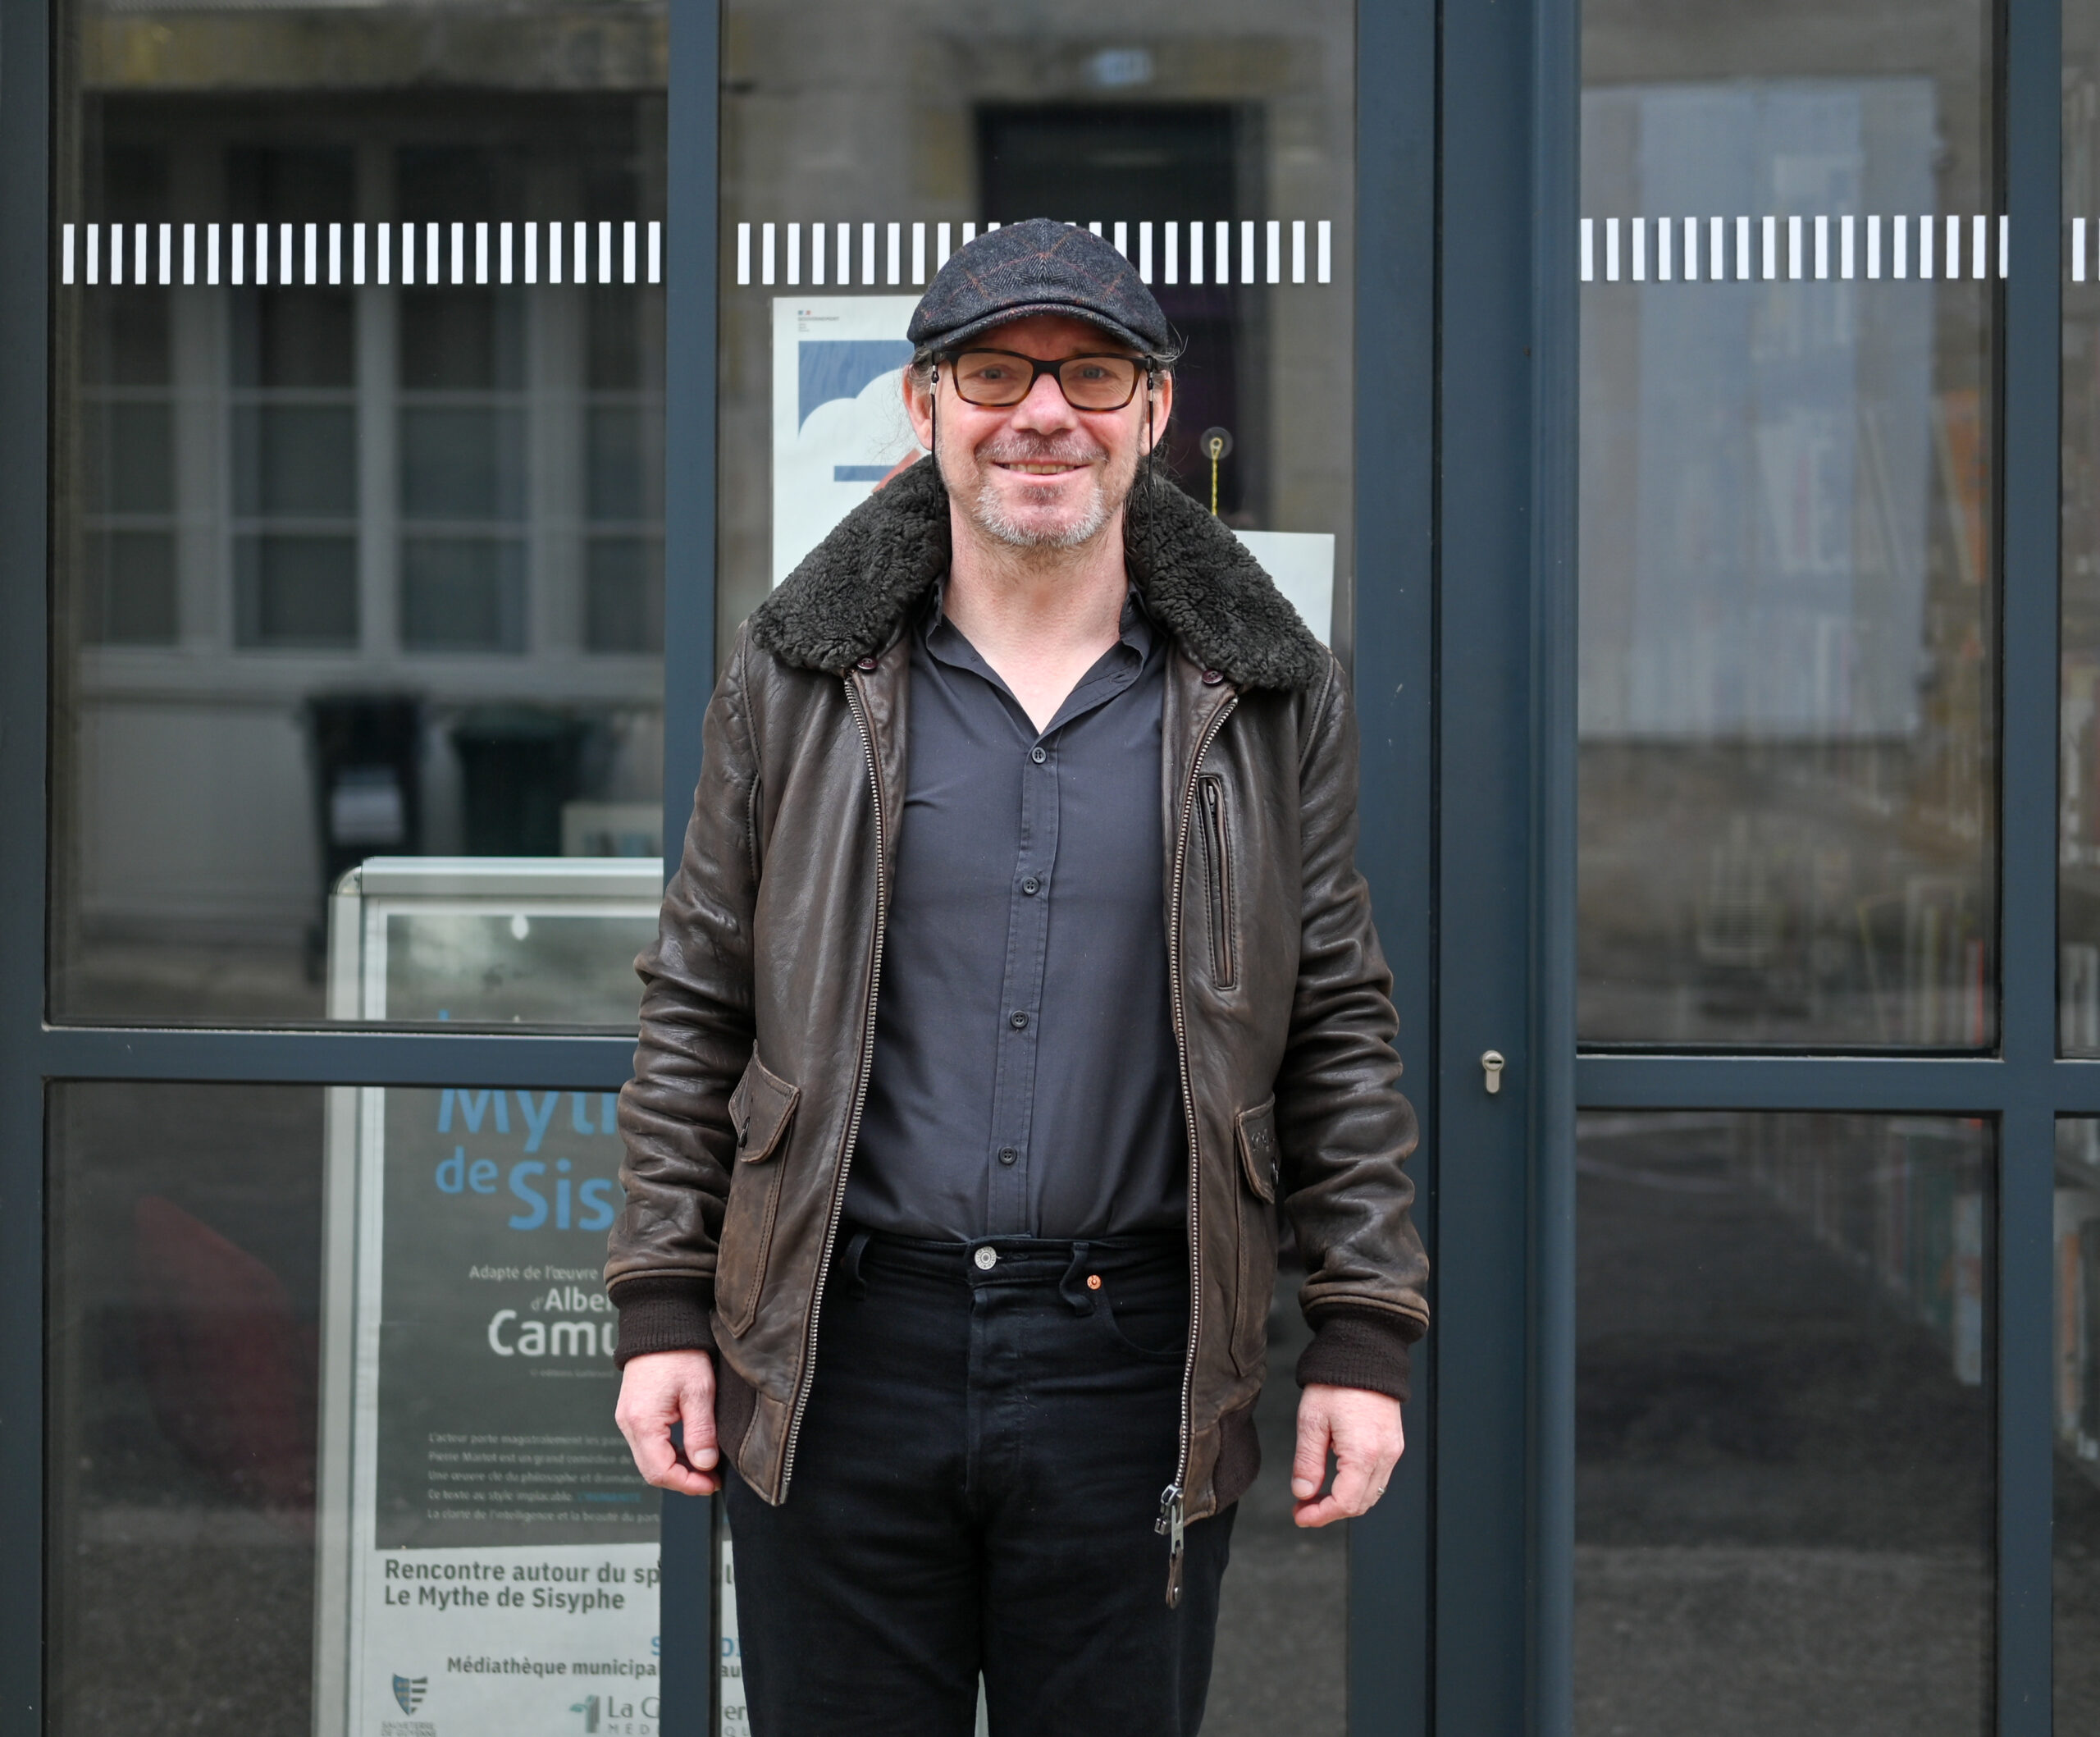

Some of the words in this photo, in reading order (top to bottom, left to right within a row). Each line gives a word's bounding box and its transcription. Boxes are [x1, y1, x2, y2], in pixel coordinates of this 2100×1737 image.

[436, 1145, 499, 1195] de
[508, 1158, 614, 1232] Sis
[523, 1264, 541, 1281] de
[385, 1558, 505, 1581] Rencontre
[512, 1561, 590, 1582] autour
[596, 1561, 626, 1583] du
[385, 1585, 410, 1605] Le
[418, 1585, 490, 1611] Mythe
[496, 1586, 525, 1607] de
[532, 1587, 625, 1614] Sisyphe
[447, 1657, 567, 1678] Médiathèque
[573, 1659, 657, 1679] municipa
[608, 1695, 633, 1718] La
